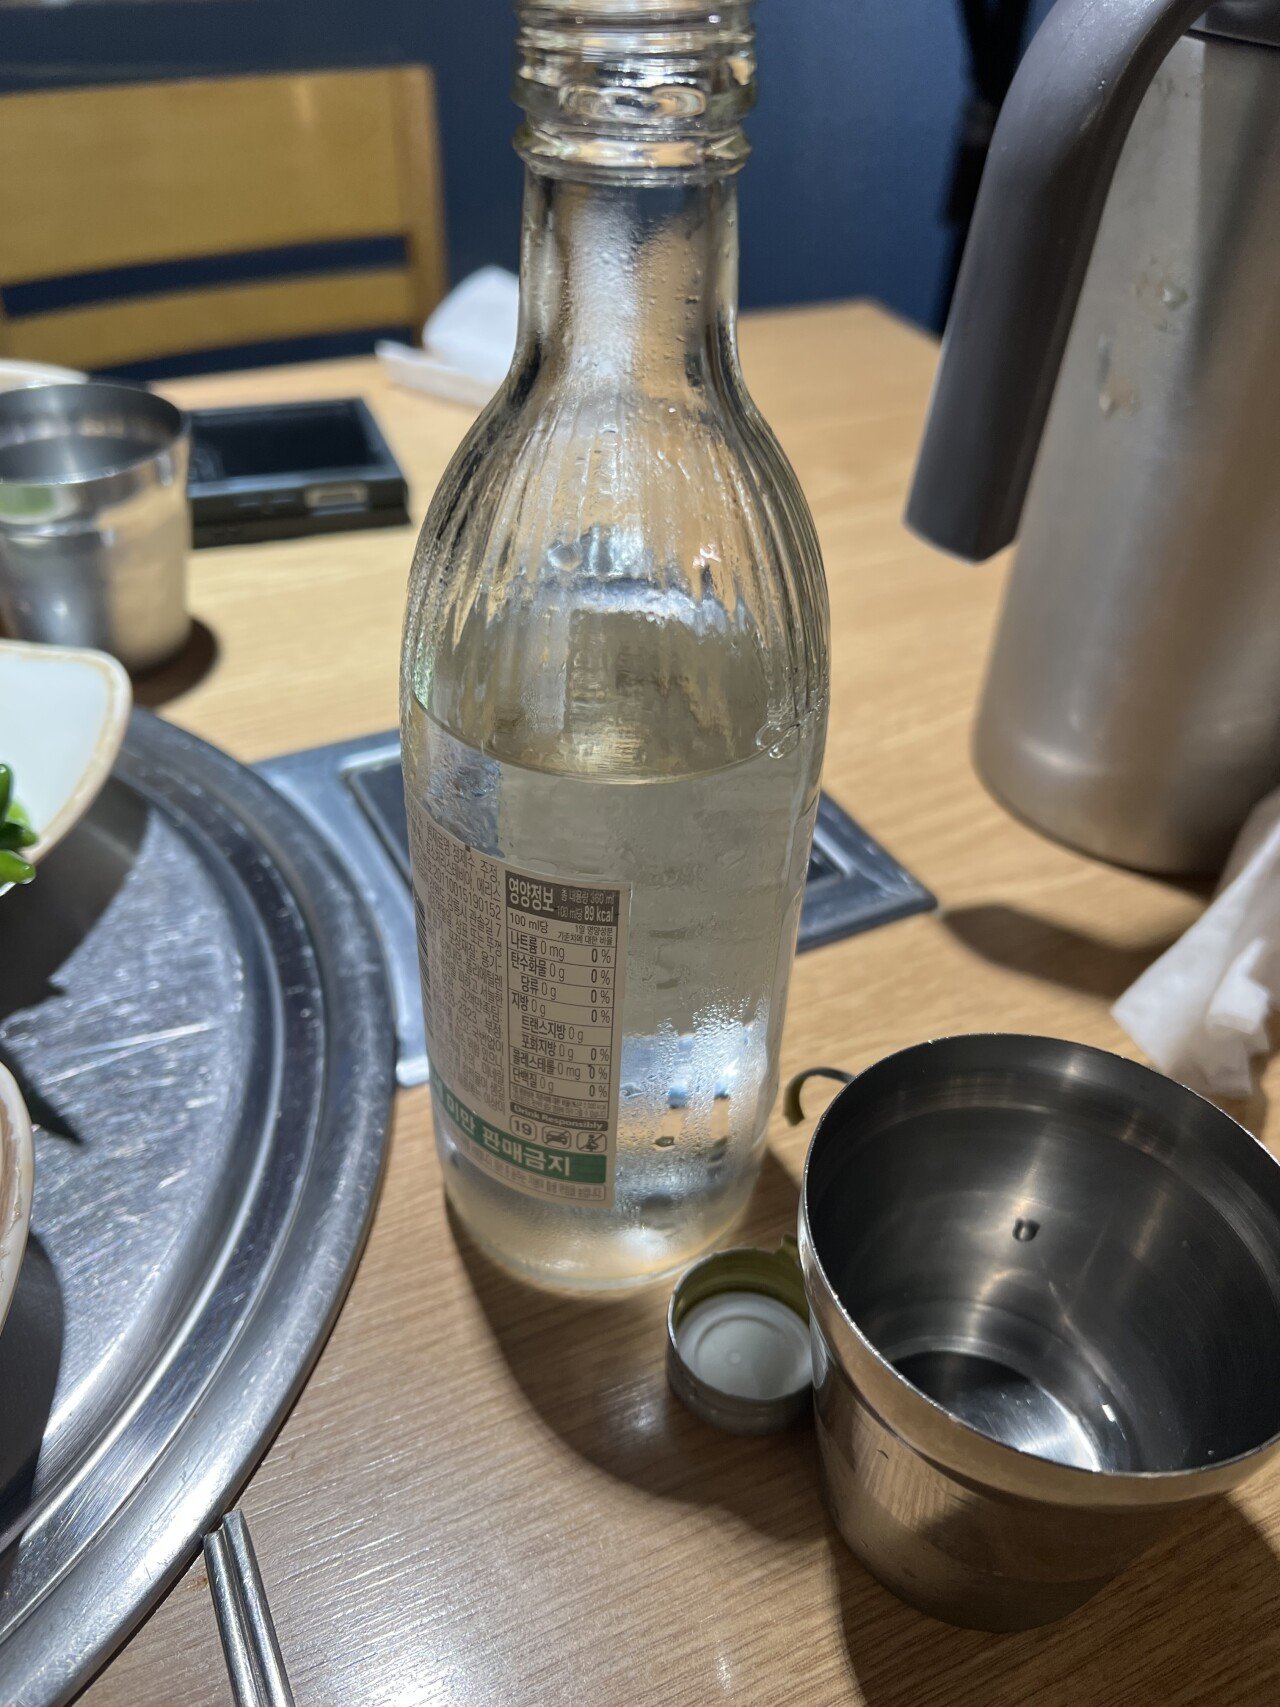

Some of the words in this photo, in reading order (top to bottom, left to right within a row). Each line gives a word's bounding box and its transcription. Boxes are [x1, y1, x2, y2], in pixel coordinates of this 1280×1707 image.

[479, 857, 500, 886] 주정,
[475, 874, 501, 904] 에리스
[508, 877, 554, 912] 영양정보
[510, 912, 526, 927] 100
[528, 919, 549, 934] ml당
[584, 905, 595, 921] 89
[596, 906, 614, 922] kcal
[469, 925, 485, 951] 또는
[486, 934, 502, 958] 뚜껑
[495, 921, 501, 939] 7
[510, 931, 537, 955] 나트륨
[511, 951, 547, 978] 탄수화물
[479, 981, 503, 1009] 서늘한
[520, 975, 539, 996] 당류
[512, 992, 529, 1012] 지방
[521, 1014, 566, 1040] 트랜스지방
[521, 1034, 556, 1057] 포화지방
[512, 1067, 537, 1089] 단백질
[513, 1120, 532, 1136] 19
[514, 1105, 540, 1120] Drink
[541, 1114, 604, 1130] Responsibly
[482, 1126, 570, 1177] 판매금지
